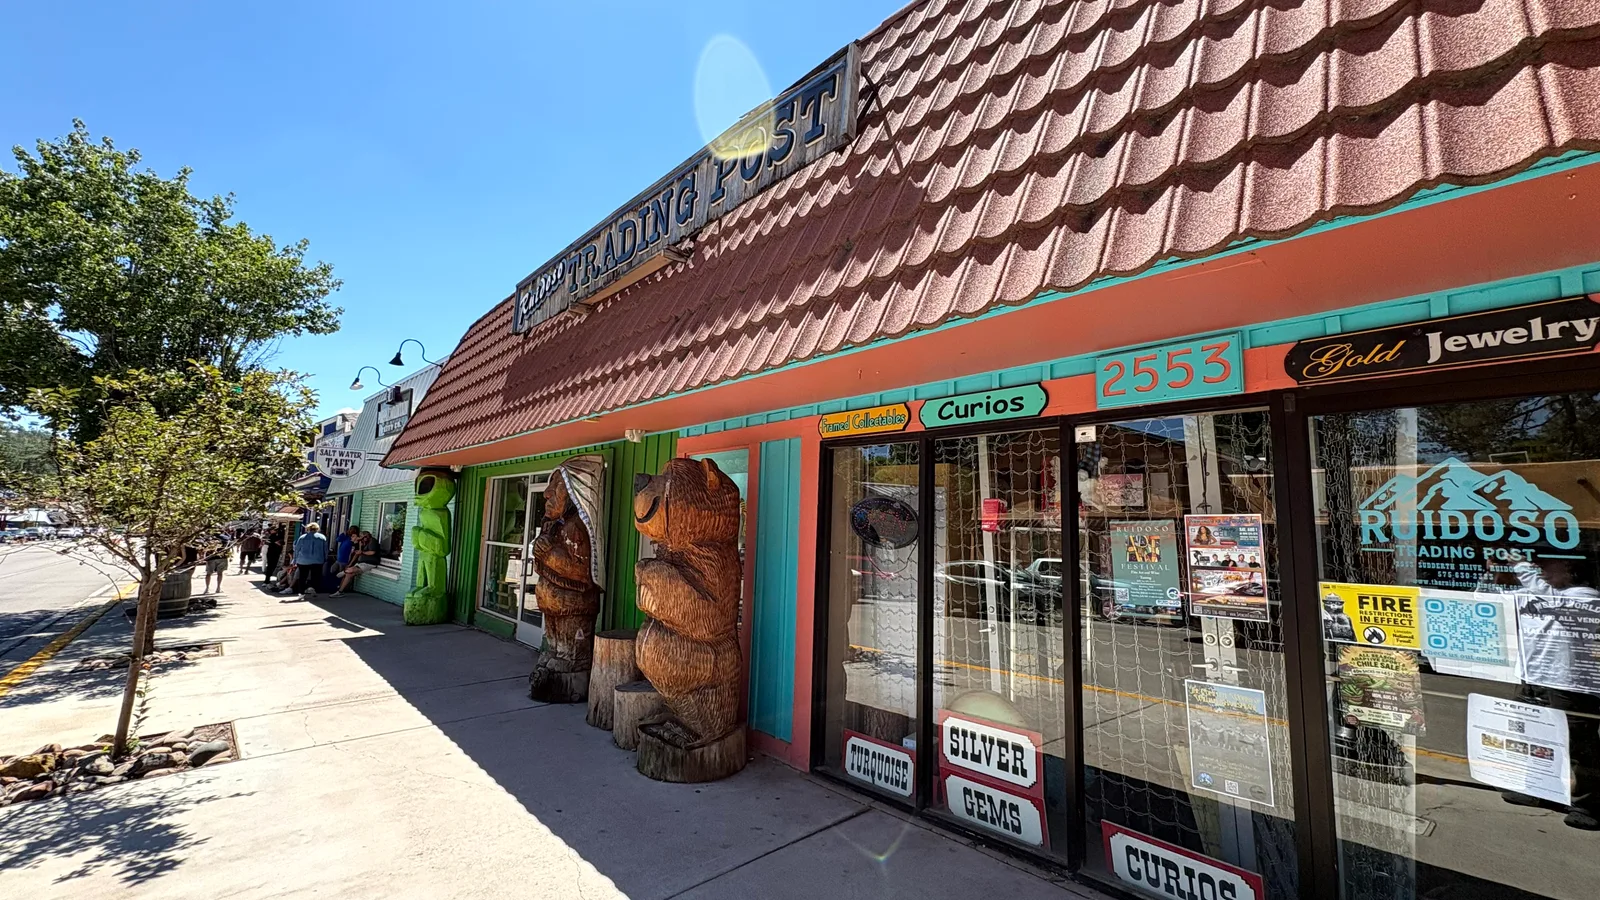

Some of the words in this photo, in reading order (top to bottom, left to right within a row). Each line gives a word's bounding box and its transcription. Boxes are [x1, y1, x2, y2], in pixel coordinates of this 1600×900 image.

[567, 172, 698, 294] TRADING
[711, 73, 839, 206] POST
[1302, 339, 1407, 378] Gold
[1425, 315, 1600, 363] Jewelry
[1103, 341, 1232, 397] 2553
[938, 395, 1025, 420] Curios
[821, 416, 850, 433] Framed
[852, 408, 906, 429] Collectables
[325, 457, 356, 469] TAFFY
[339, 450, 362, 459] WATER
[1358, 509, 1581, 550] RUIDOSO
[1395, 544, 1475, 559] TRADING
[1483, 547, 1536, 562] POST
[1121, 563, 1170, 571] FESTIVAL
[1358, 595, 1413, 613] FIRE
[1360, 610, 1413, 619] RESTRICTIONS
[1374, 616, 1413, 626] EFFECT
[1523, 627, 1579, 638] HALLOWEEN
[1423, 648, 1447, 657] Check
[1380, 662, 1400, 671] SALE
[950, 726, 1028, 778] SILVER
[850, 744, 909, 791] TURQUOISE
[963, 786, 1022, 835] GEMS
[1125, 844, 1237, 900] CURIOS
